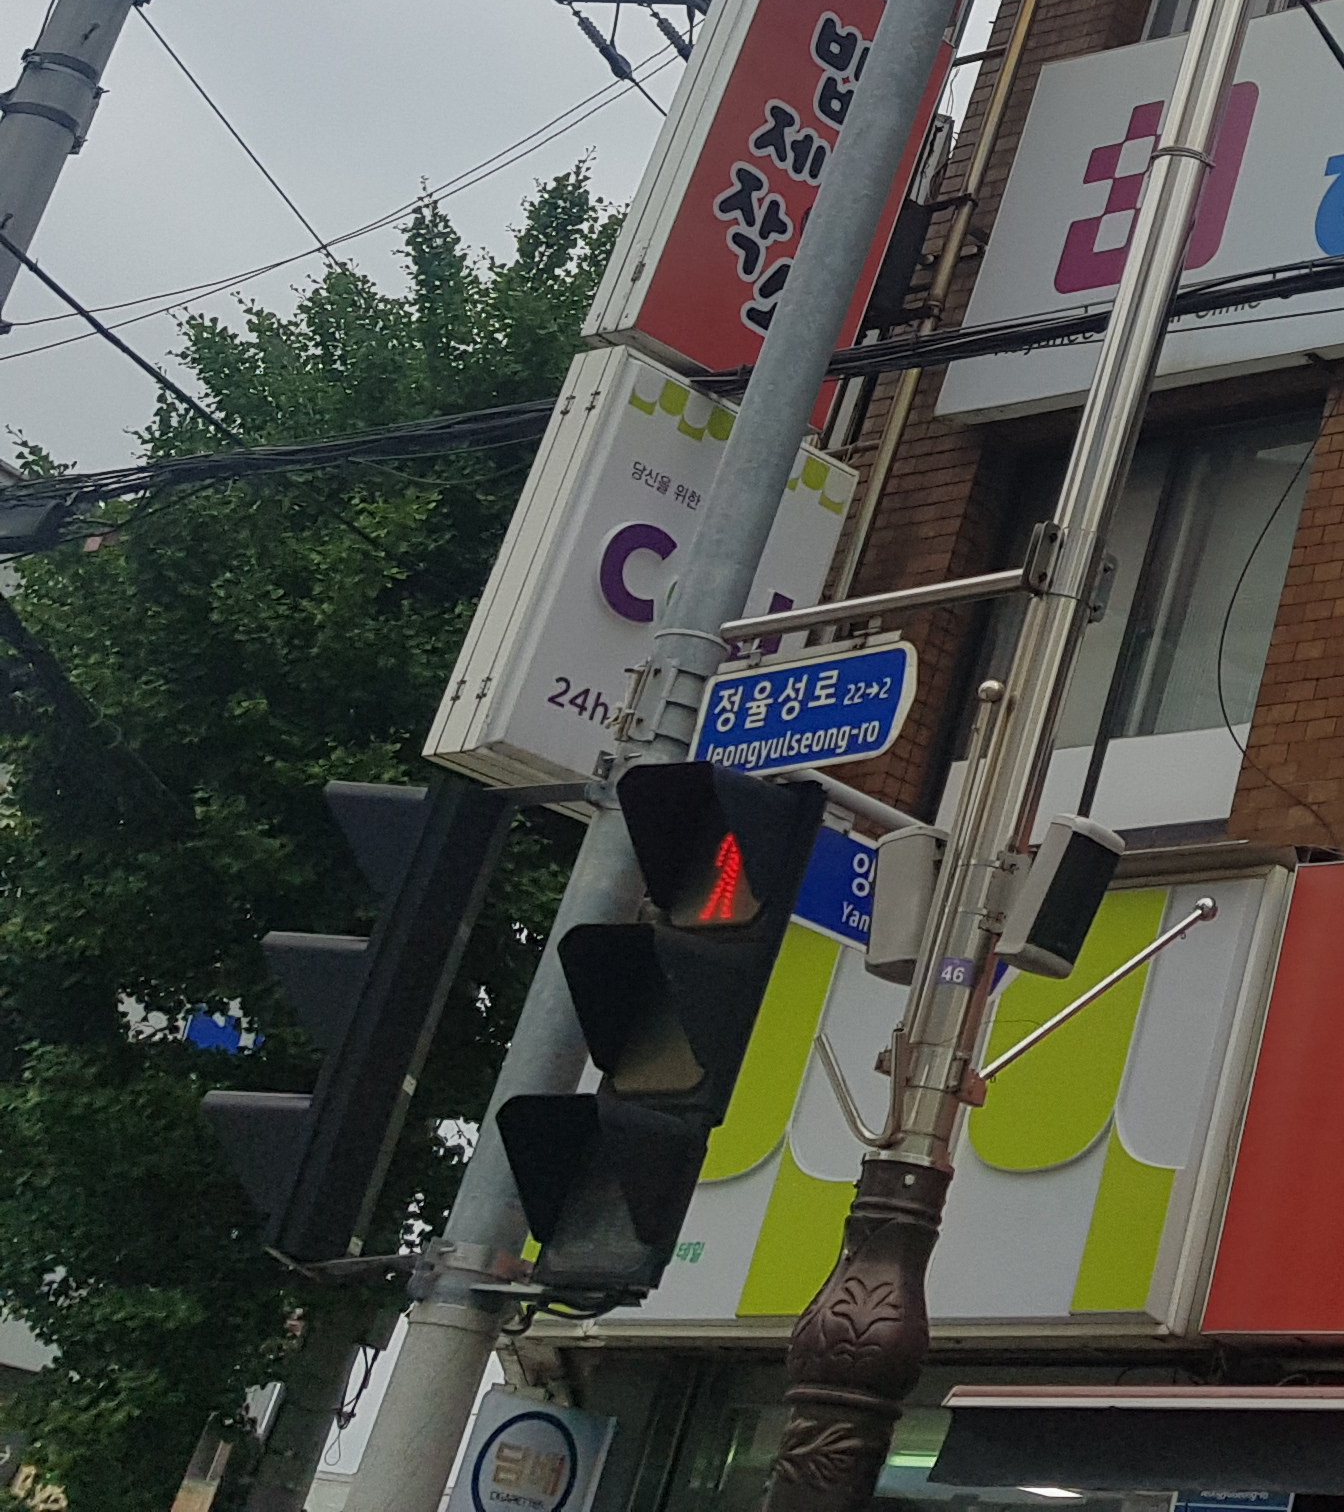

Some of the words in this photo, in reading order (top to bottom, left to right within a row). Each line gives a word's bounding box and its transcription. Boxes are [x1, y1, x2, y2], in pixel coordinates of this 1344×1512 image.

[631, 460, 672, 495] 당신을
[714, 669, 840, 733] 정율성로
[941, 965, 966, 983] 46
